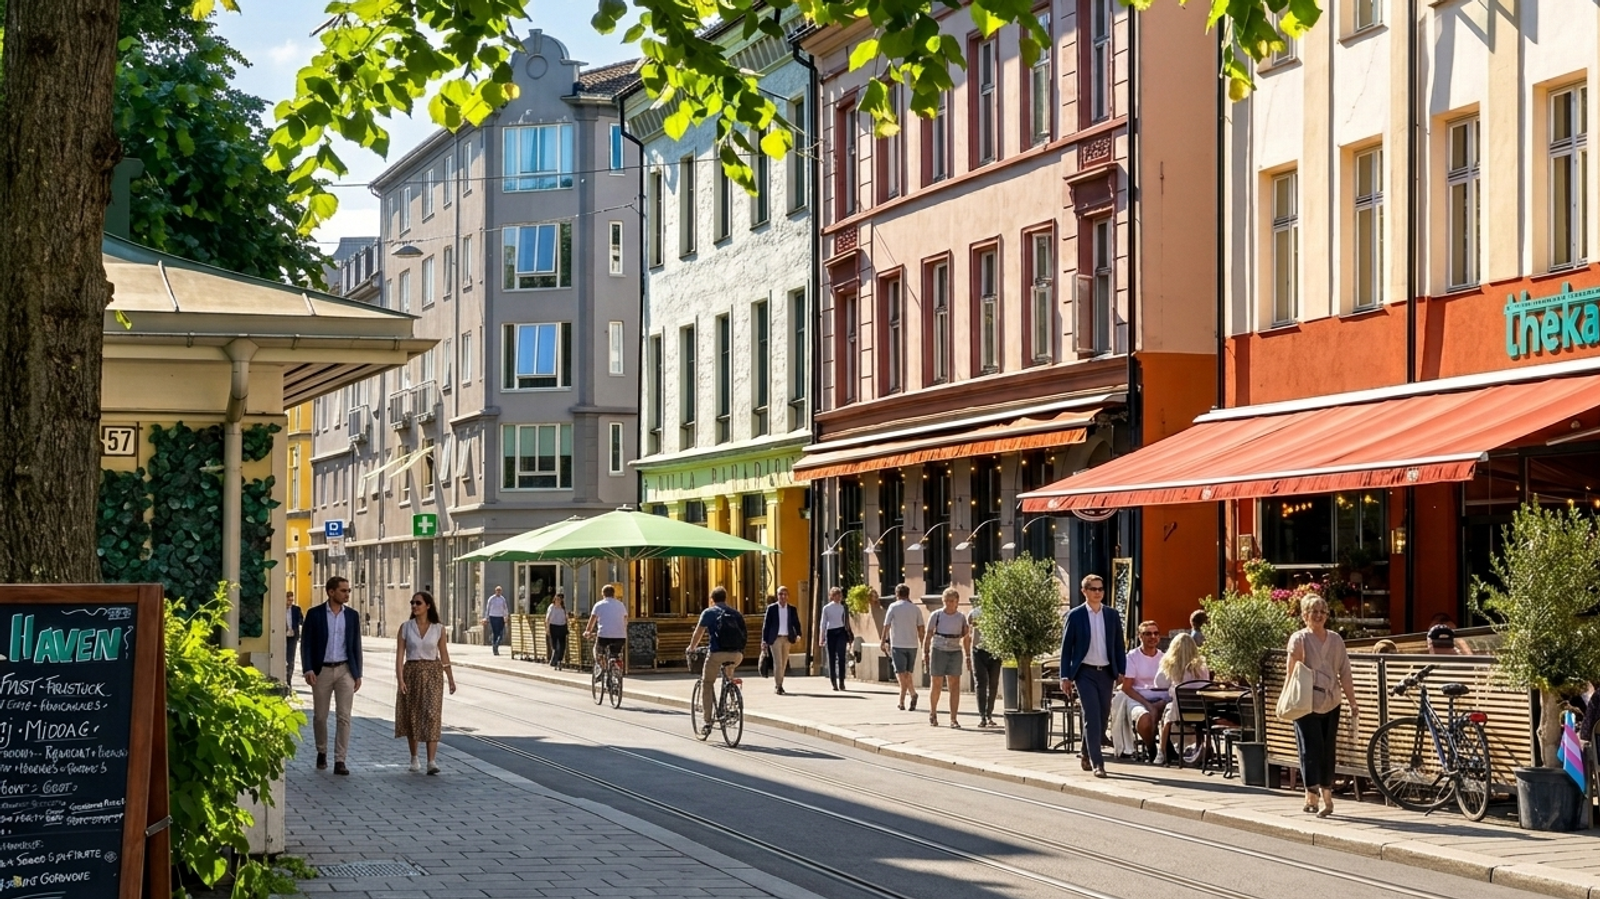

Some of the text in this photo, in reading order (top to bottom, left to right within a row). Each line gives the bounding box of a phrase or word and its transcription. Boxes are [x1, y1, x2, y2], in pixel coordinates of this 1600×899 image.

[1503, 281, 1600, 357] theka
[108, 430, 131, 452] 57
[9, 612, 121, 663] HAVEN
